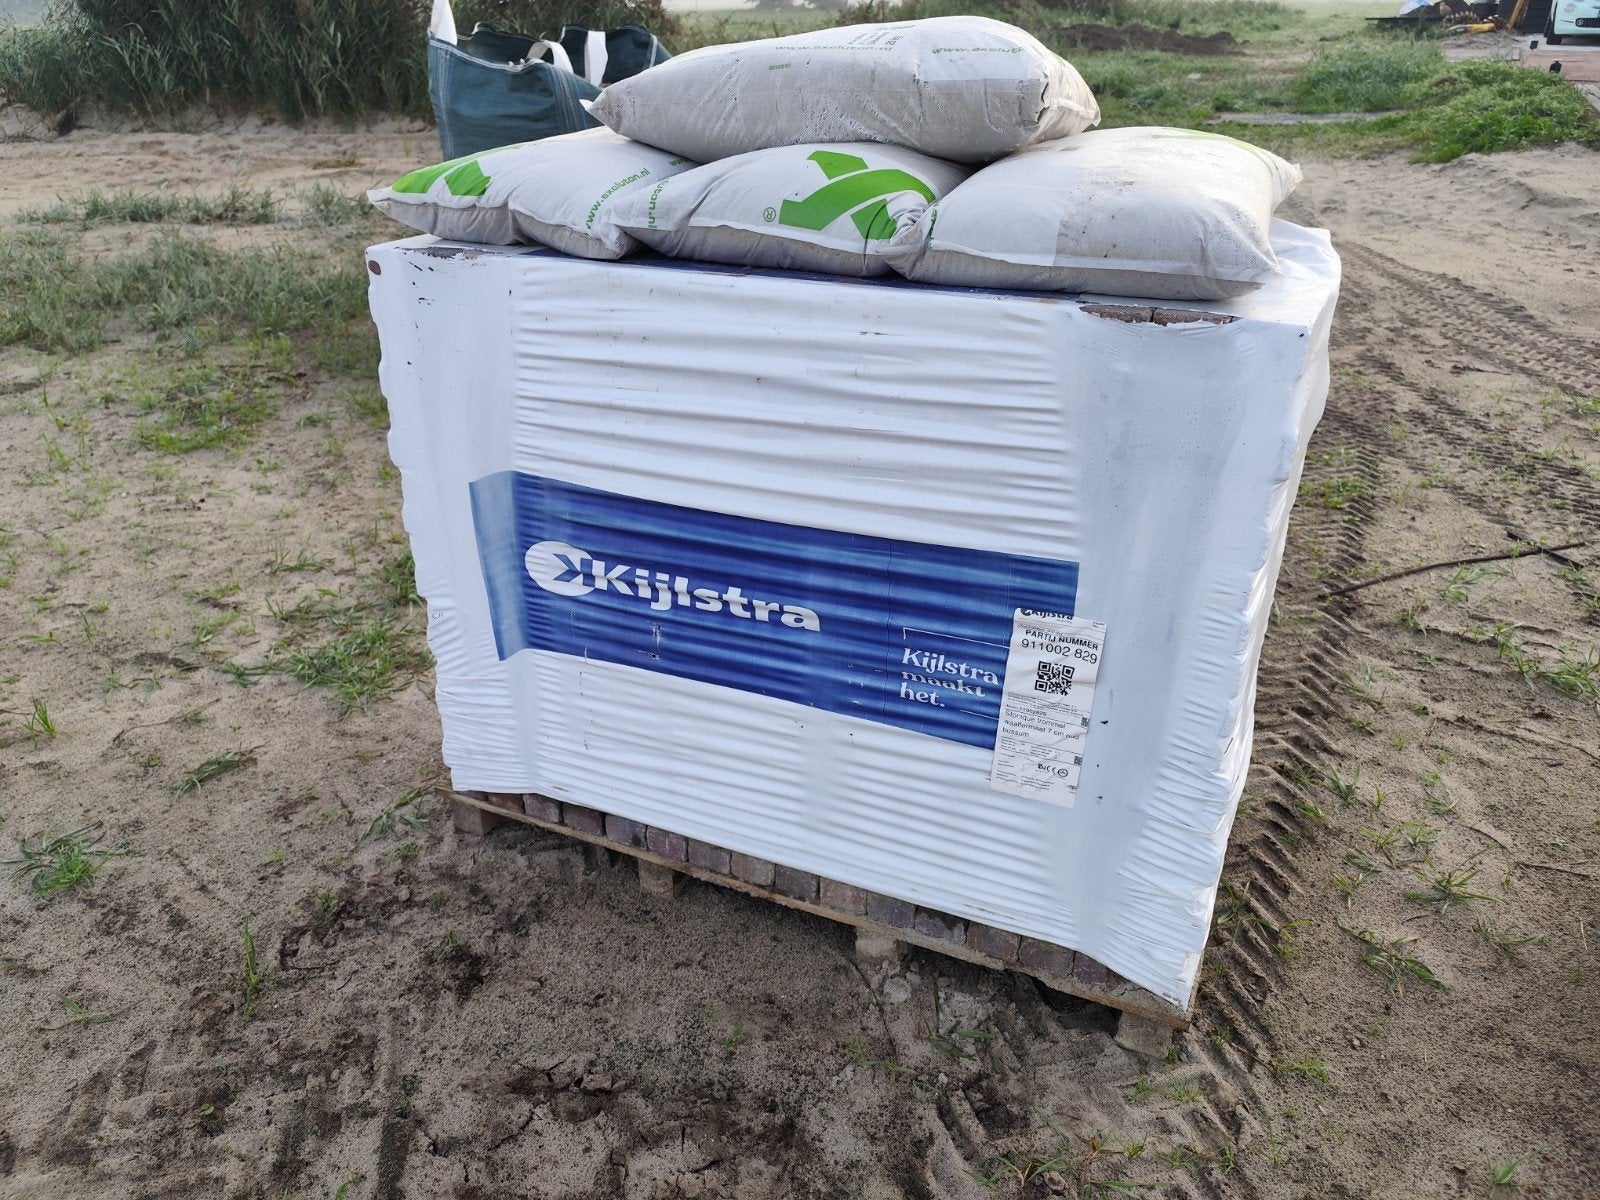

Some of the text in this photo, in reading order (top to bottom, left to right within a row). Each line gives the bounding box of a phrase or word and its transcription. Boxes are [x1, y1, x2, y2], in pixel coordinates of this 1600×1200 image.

[593, 559, 821, 632] Kijlstra
[1021, 638, 1098, 665] 911002 829
[1025, 629, 1056, 643] PARTIJ
[1058, 636, 1099, 651] NUMMER
[901, 647, 999, 686] Kijlstra
[900, 671, 986, 698] maakt
[900, 681, 946, 708] het.
